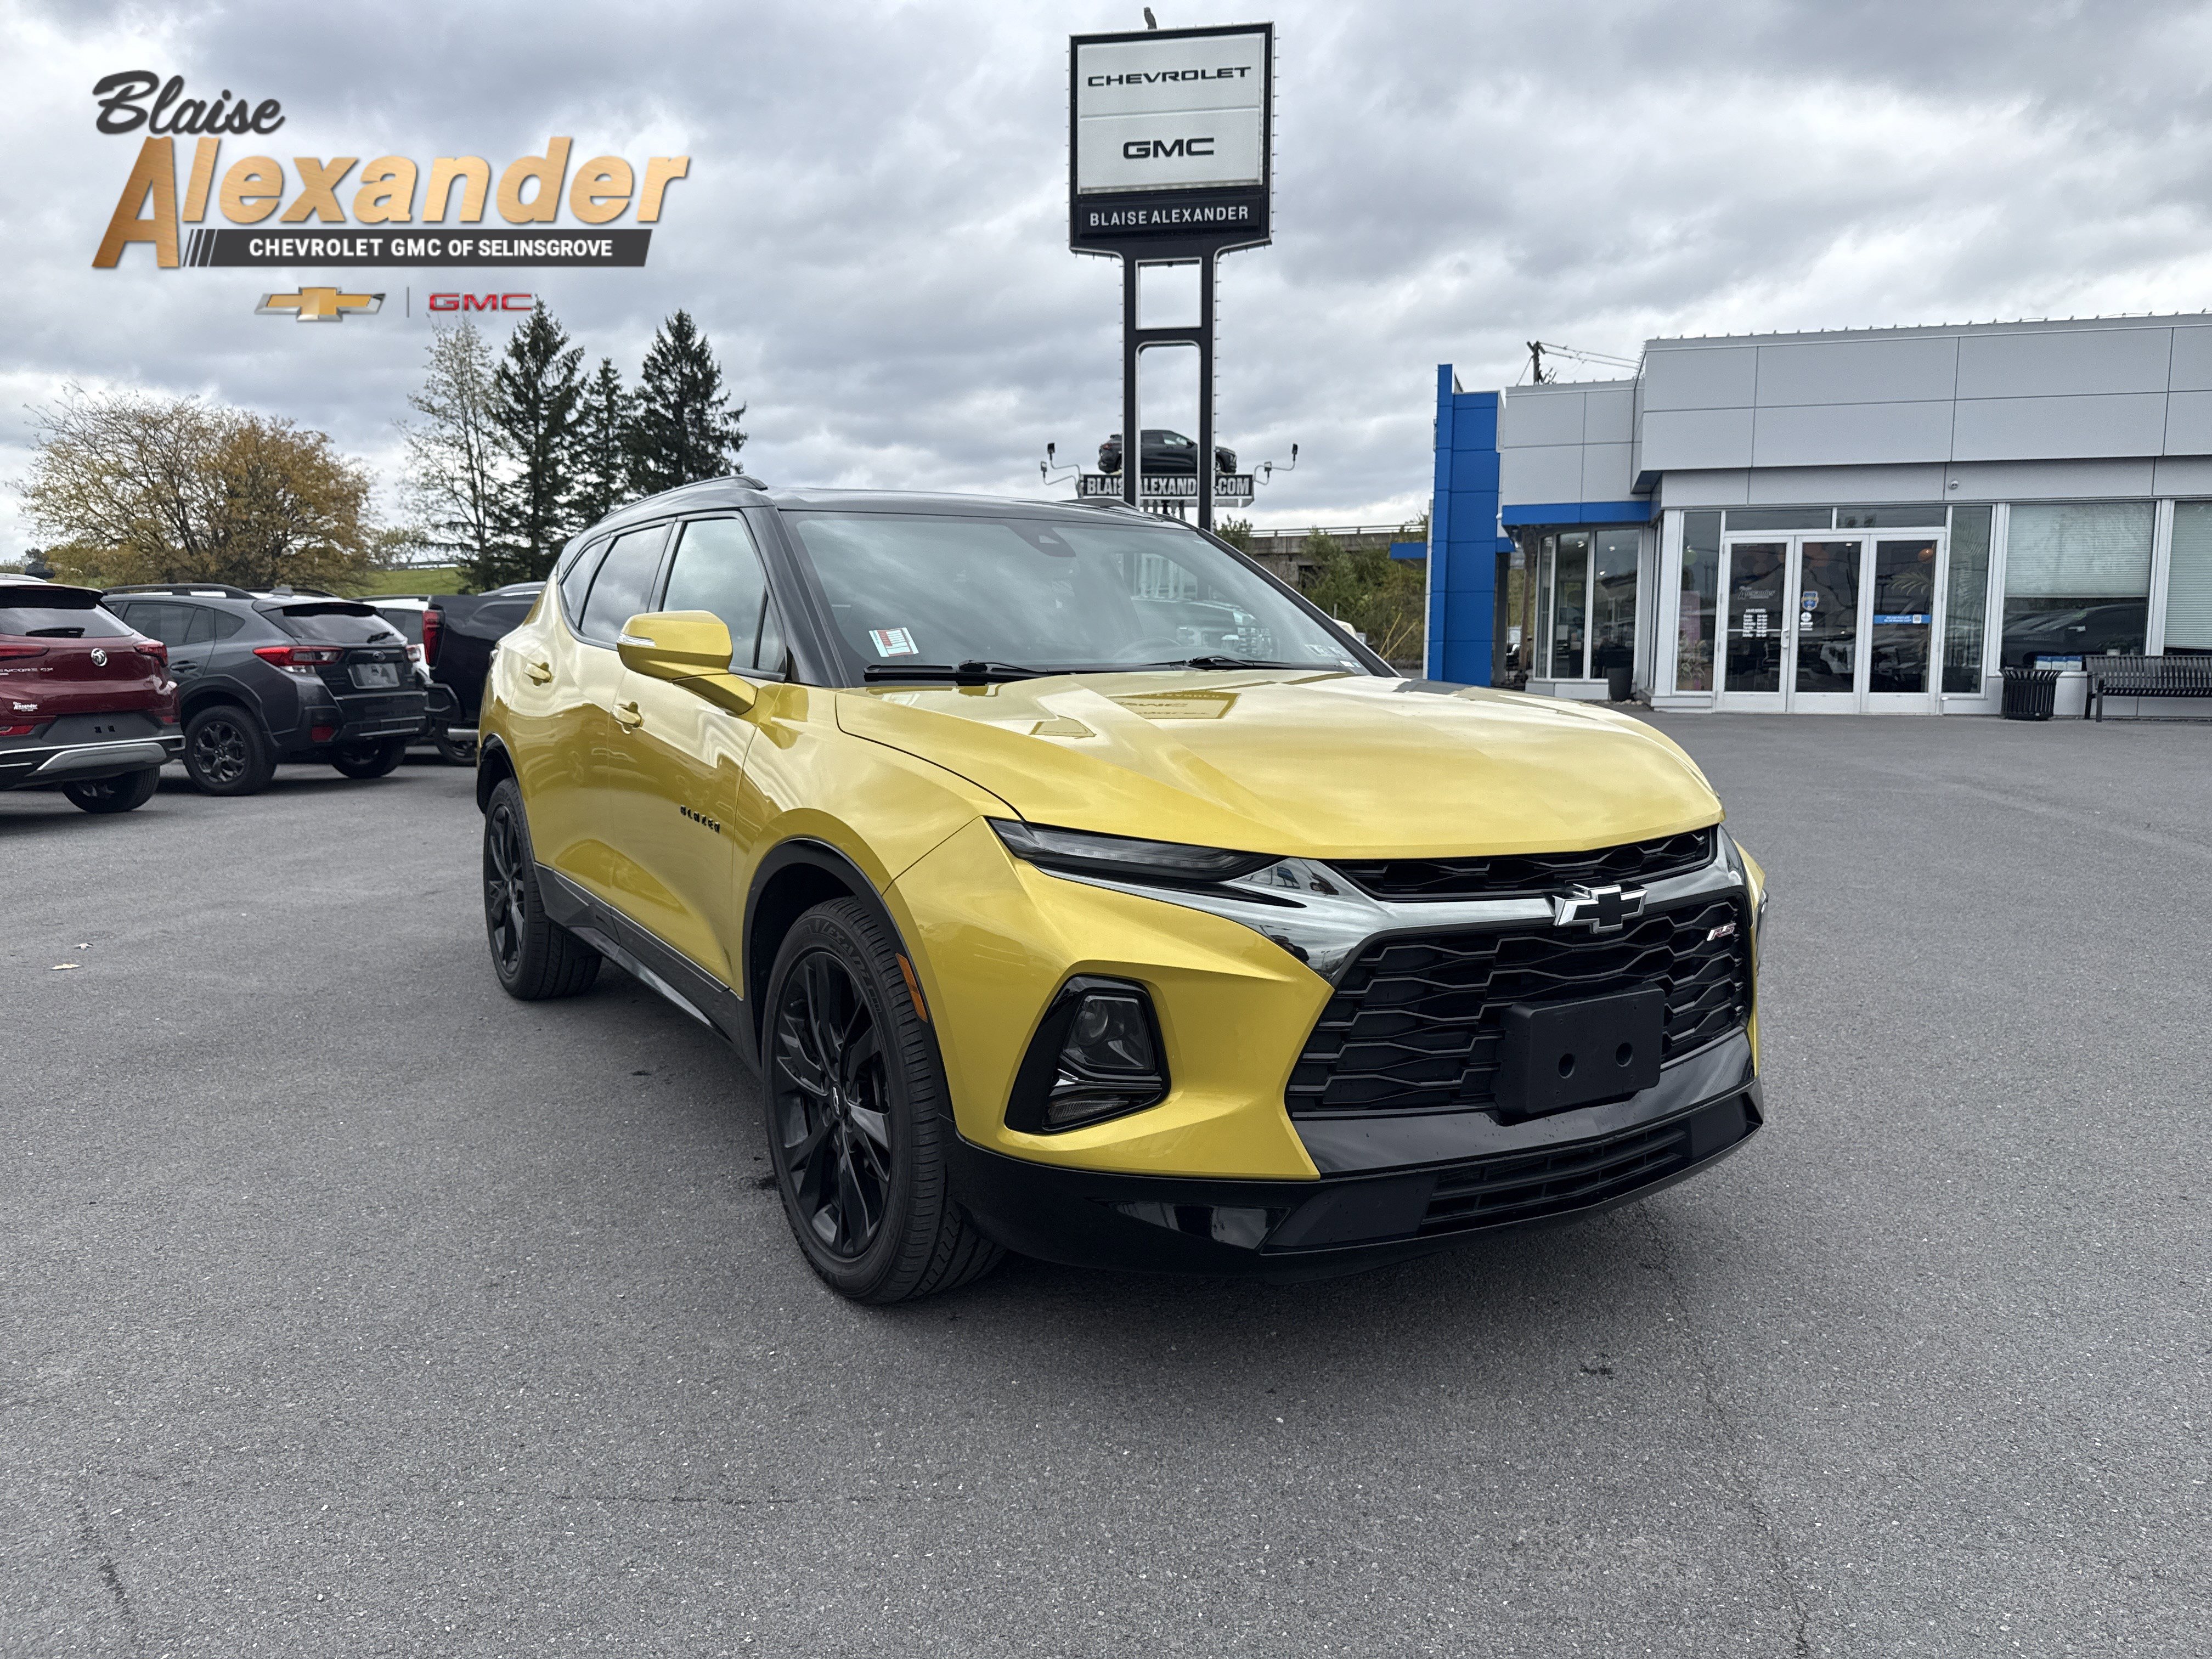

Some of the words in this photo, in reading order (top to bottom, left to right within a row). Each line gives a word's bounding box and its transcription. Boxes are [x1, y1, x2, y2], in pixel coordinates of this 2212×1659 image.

[1088, 66, 1251, 87] CHEVROLET
[1123, 137, 1214, 159] GMC
[1090, 211, 1147, 227] BLAISE
[1151, 206, 1249, 224] ALEXANDER
[1706, 922, 1736, 941] RS
